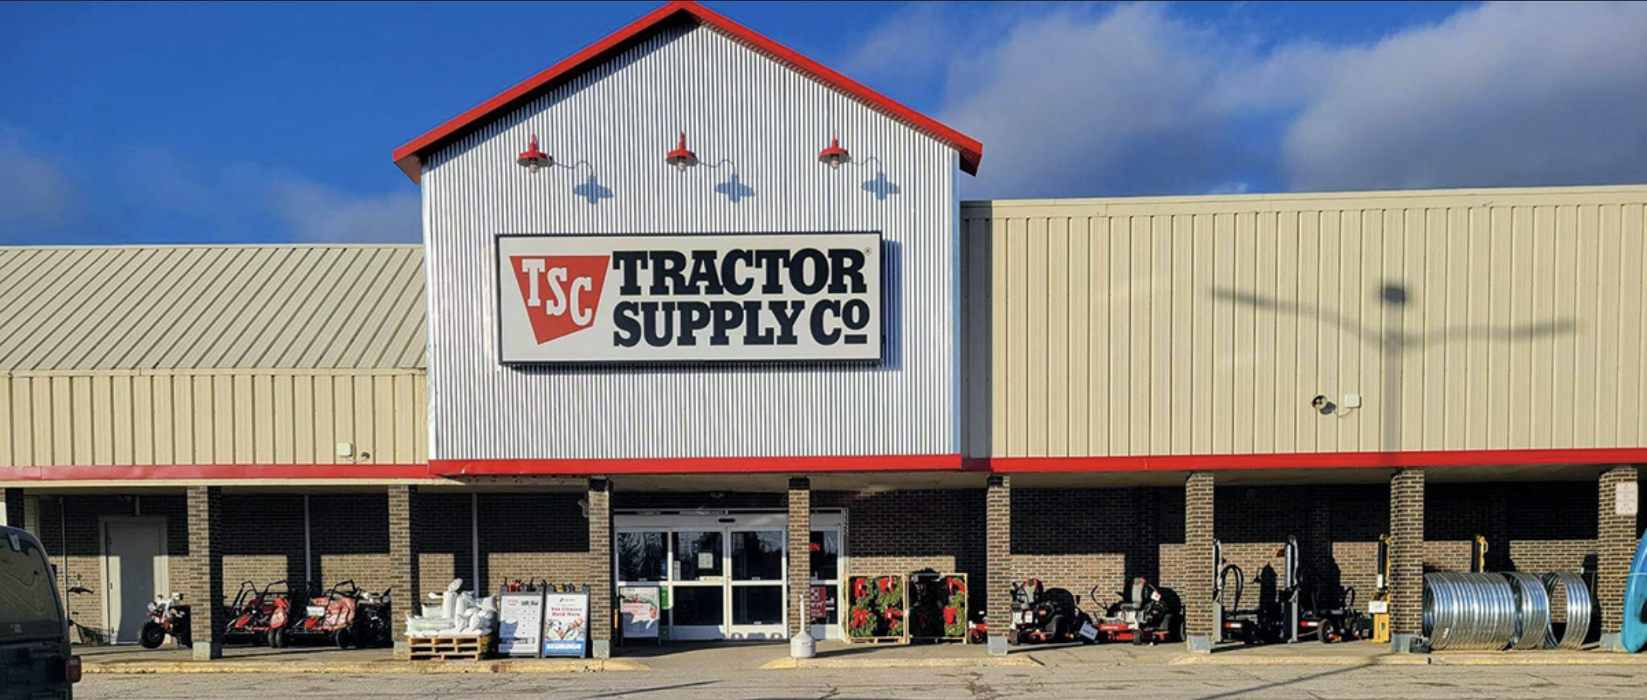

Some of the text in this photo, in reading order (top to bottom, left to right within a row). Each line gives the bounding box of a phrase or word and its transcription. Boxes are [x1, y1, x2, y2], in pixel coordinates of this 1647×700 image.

[521, 258, 592, 326] TSC
[612, 248, 867, 296] TRACTOR
[612, 300, 805, 347] SUPPLY
